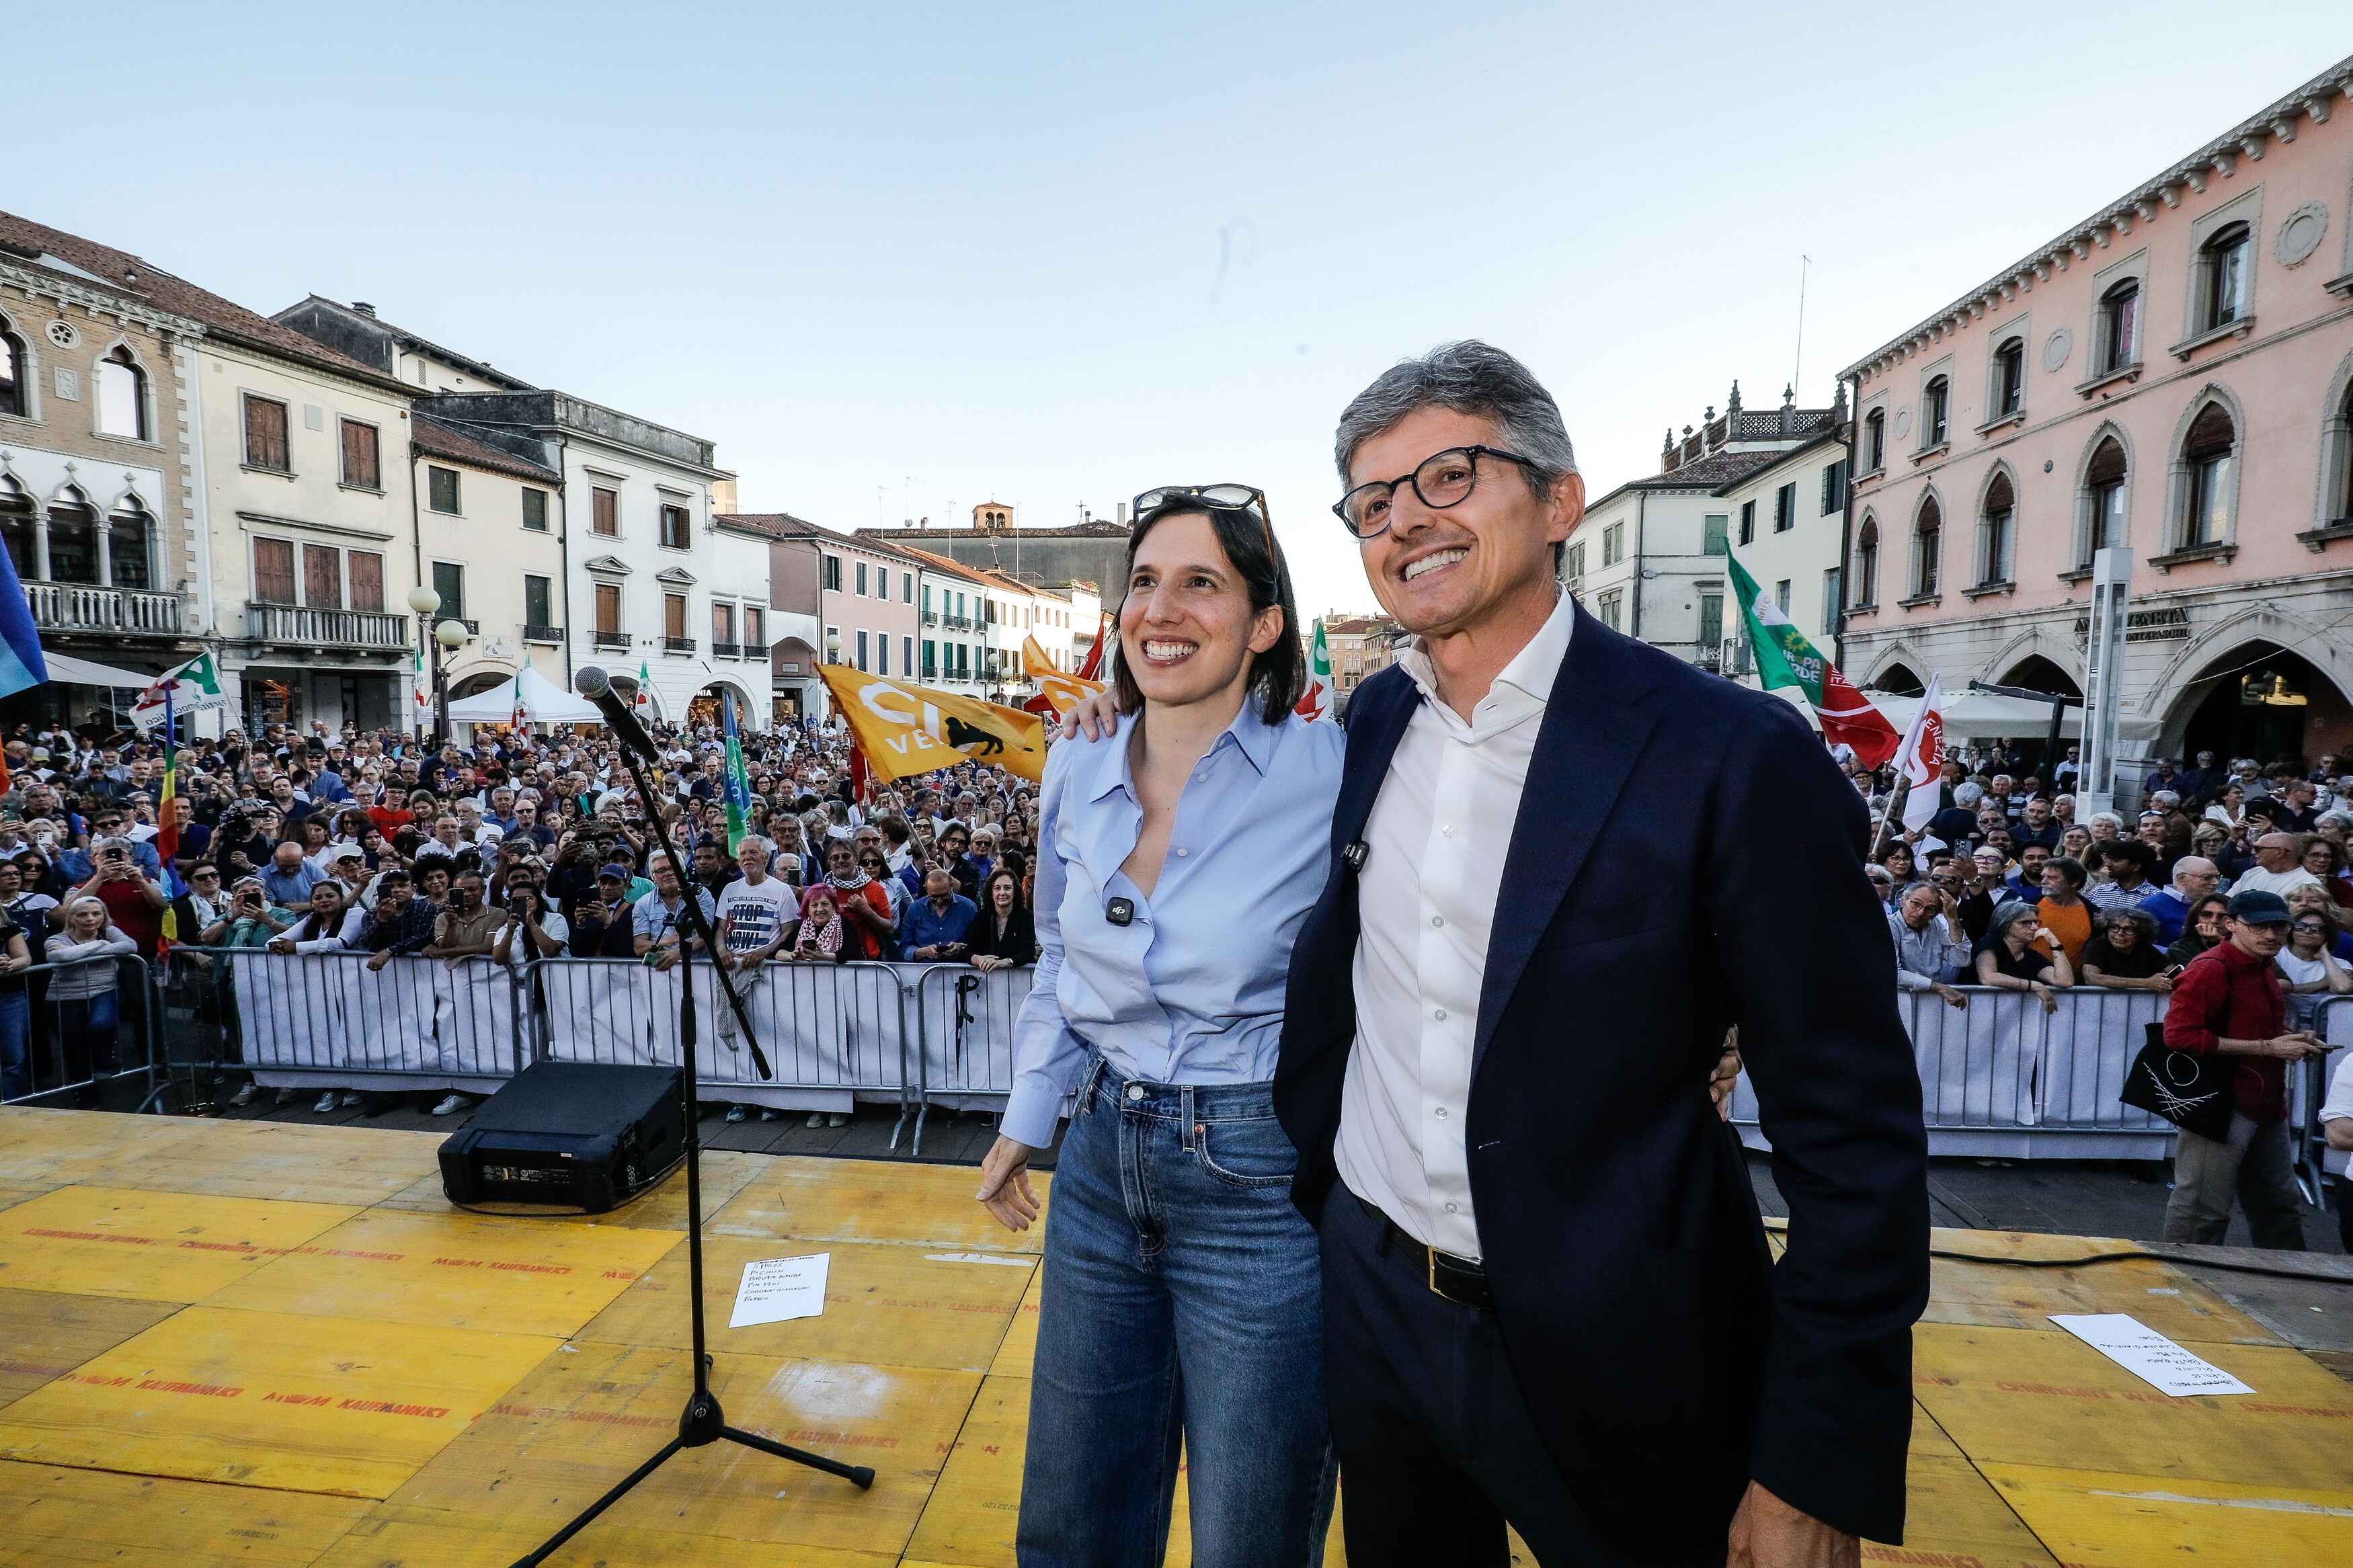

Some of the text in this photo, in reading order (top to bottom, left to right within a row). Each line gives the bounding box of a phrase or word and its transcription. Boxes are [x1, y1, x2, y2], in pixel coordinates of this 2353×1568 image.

[2126, 628, 2189, 642] ONTEPASCHI
[1830, 676, 1850, 685] ITA
[696, 689, 713, 697] NIA
[886, 729, 944, 755] VE
[1925, 717, 1944, 766] ENEZIA
[731, 905, 764, 921] STOP
[726, 932, 760, 949] NOW!
[488, 1262, 555, 1273] KAUFMANN
[134, 1379, 223, 1397] KAUFMANN
[336, 1399, 432, 1417] KAUFMANN
[784, 1429, 878, 1446] KAUFMANN
[1860, 1546, 1951, 1567] UFMANN
